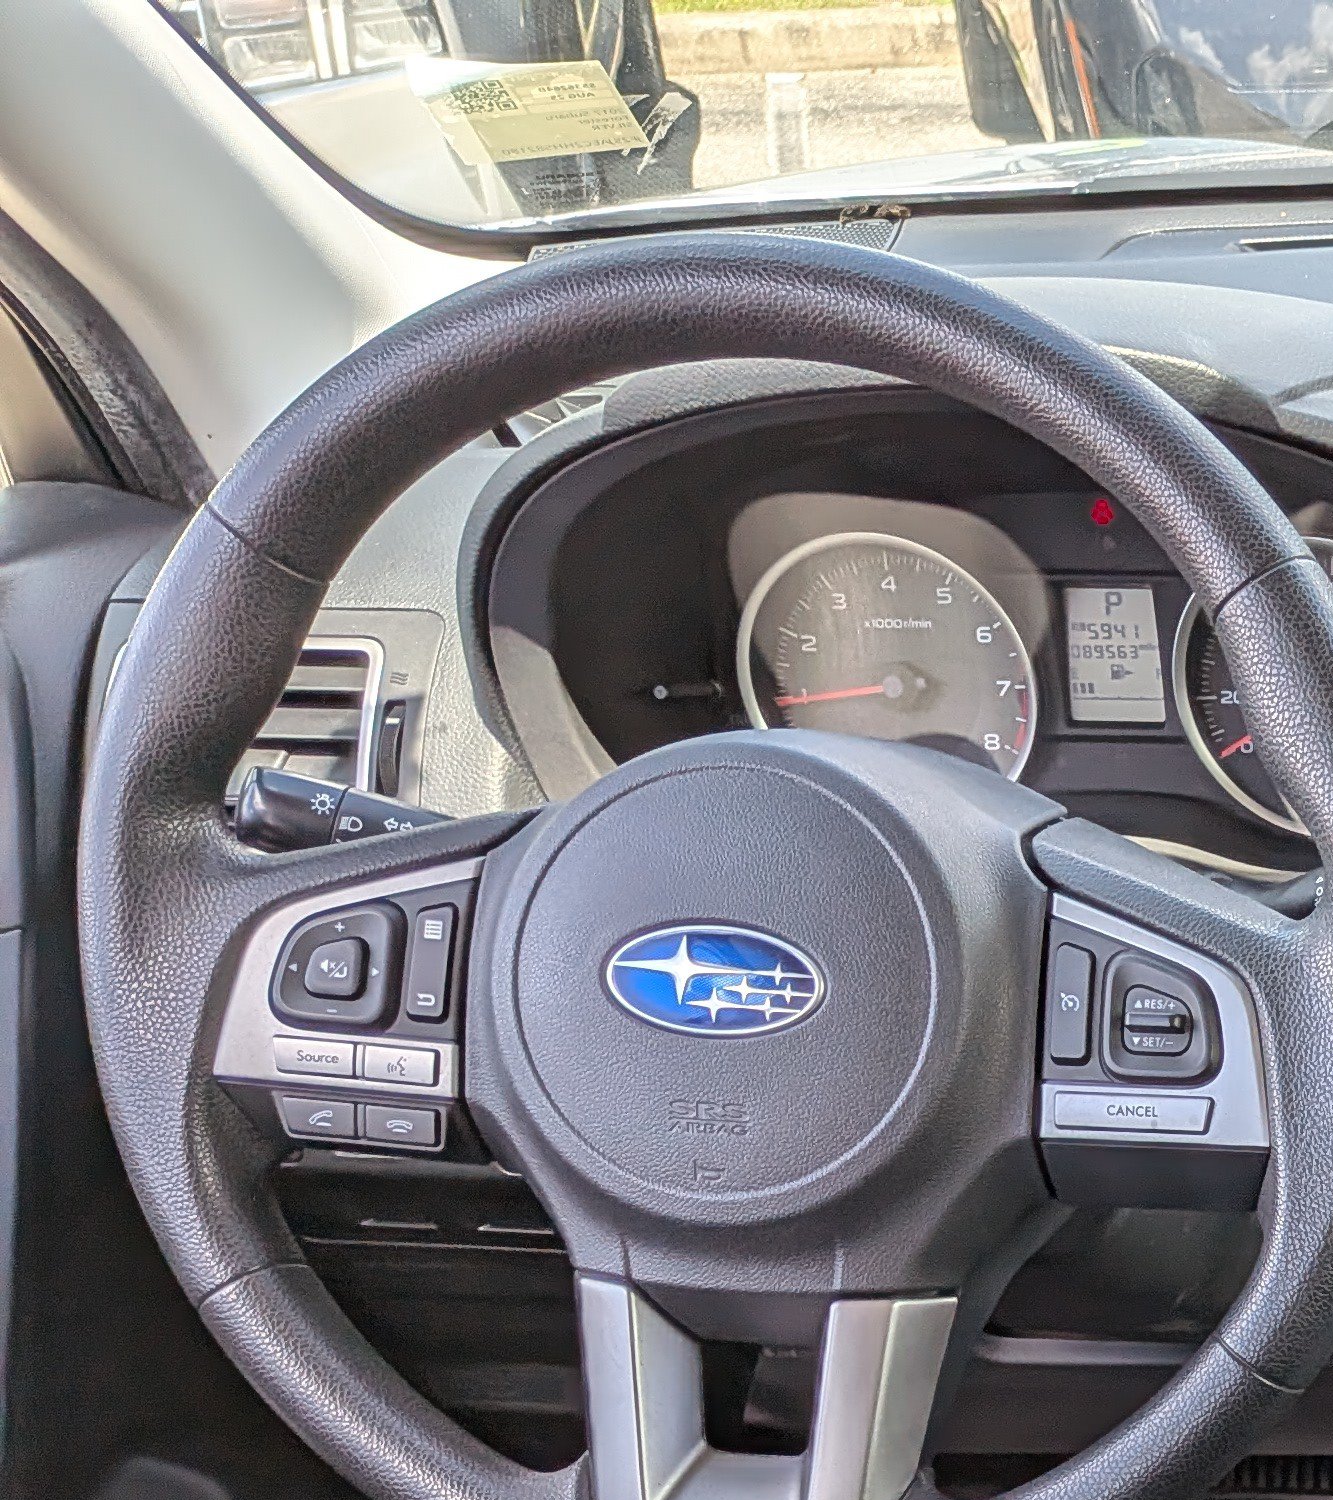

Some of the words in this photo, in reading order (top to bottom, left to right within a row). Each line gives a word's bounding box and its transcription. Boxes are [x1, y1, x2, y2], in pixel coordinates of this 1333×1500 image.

[881, 575, 897, 592] 4
[831, 592, 848, 610] 3
[936, 587, 952, 605] 5
[1104, 591, 1123, 616] P
[800, 633, 818, 652] 2
[975, 626, 992, 644] 6
[996, 680, 1011, 696] 7
[983, 733, 1000, 751] 8
[296, 1049, 340, 1064] Source
[668, 1099, 748, 1120] SRS
[1106, 1105, 1159, 1118] CANCEL
